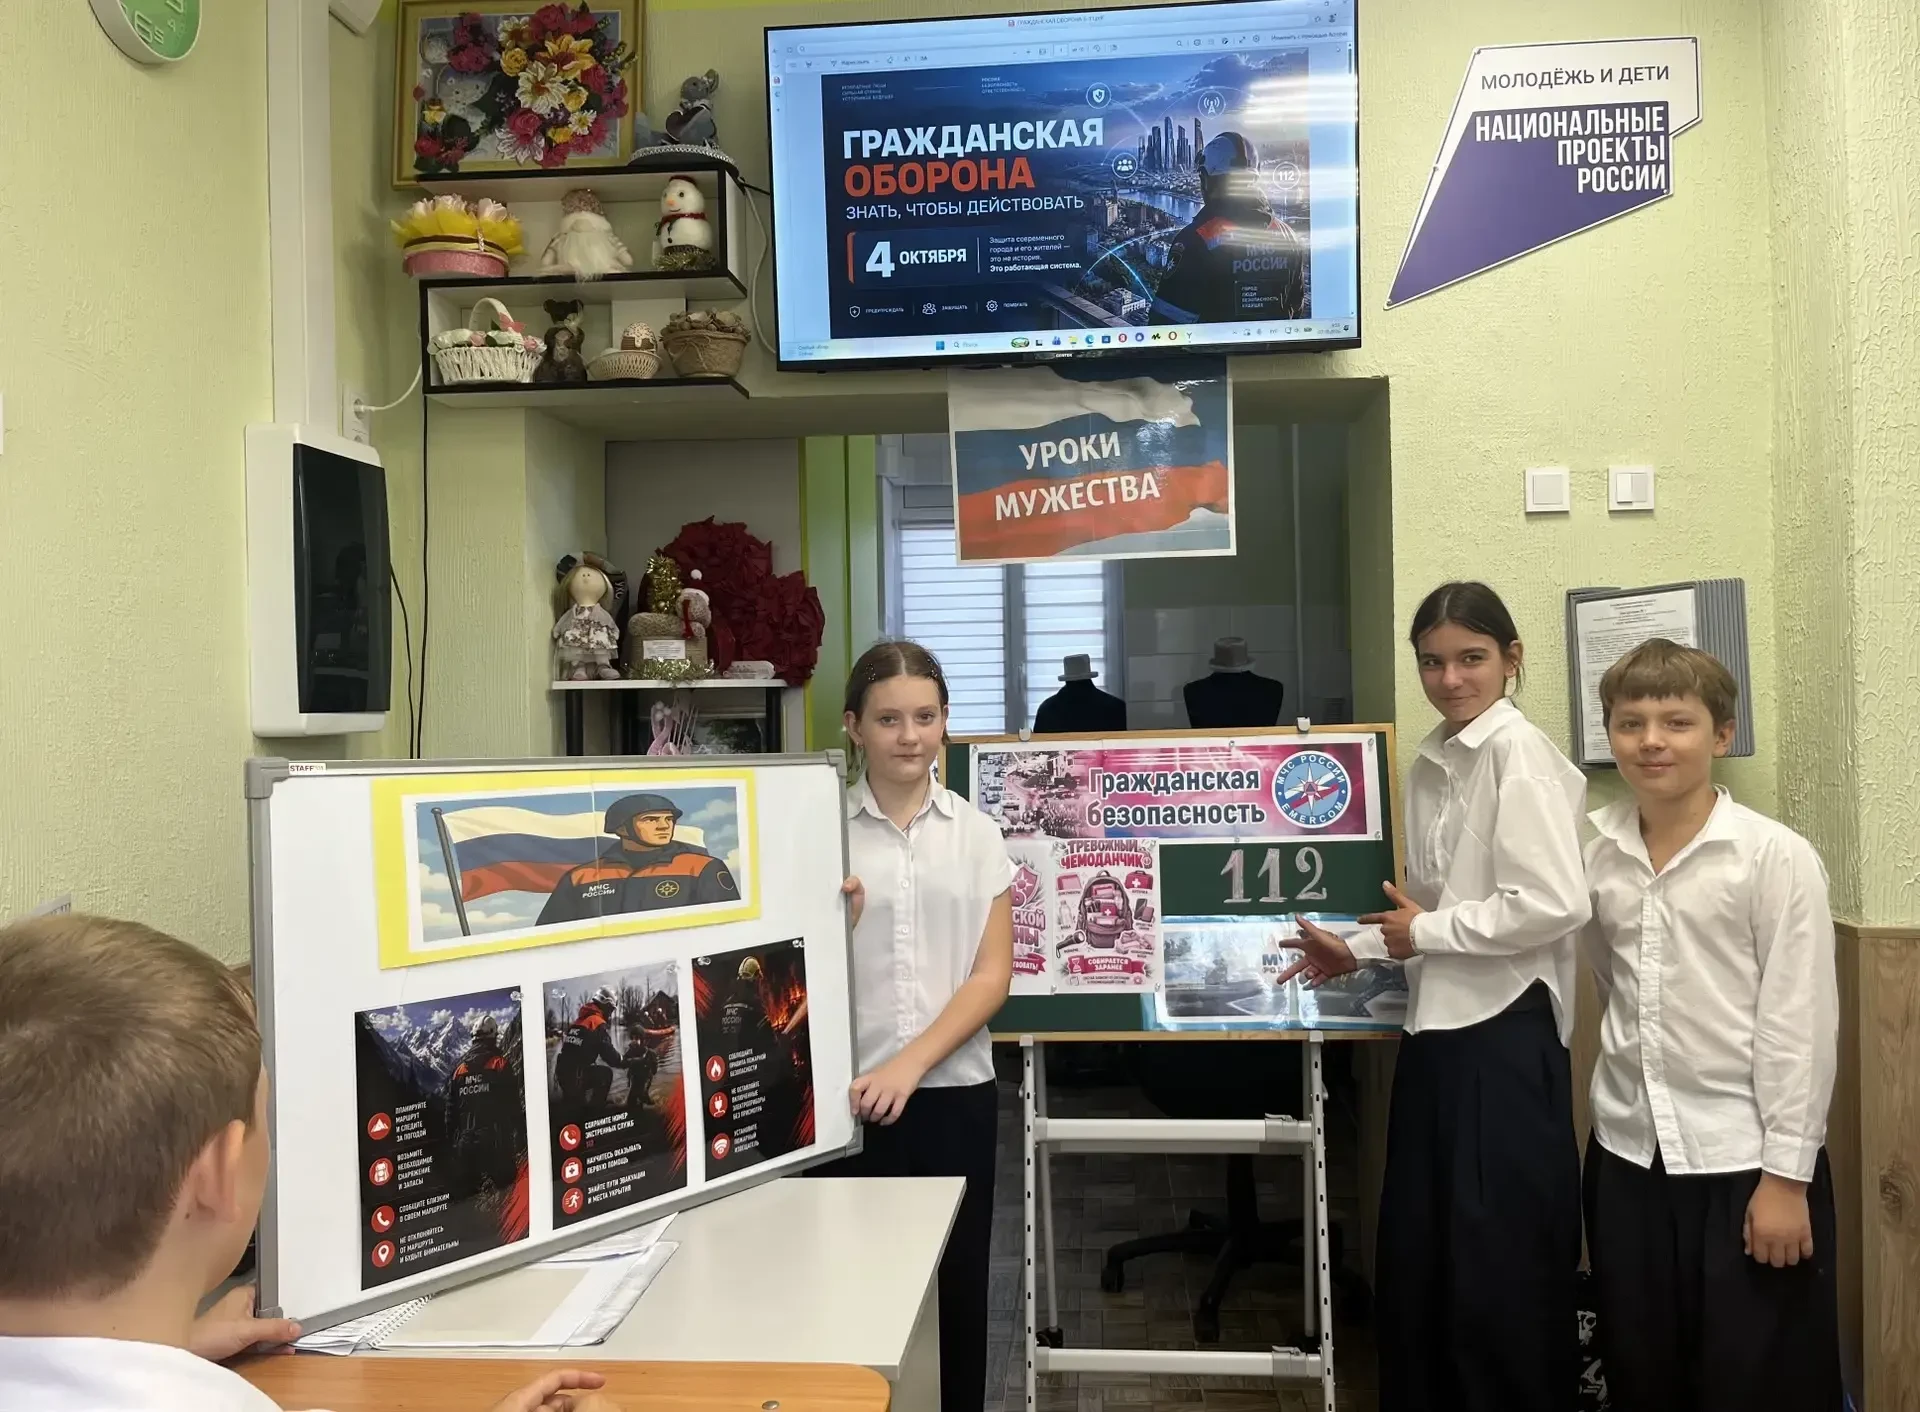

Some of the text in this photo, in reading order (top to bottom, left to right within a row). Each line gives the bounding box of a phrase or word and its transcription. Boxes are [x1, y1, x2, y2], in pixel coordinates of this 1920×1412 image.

[1481, 66, 1670, 90] МОЛОДЁЖЬ И ДЕТИ
[1475, 106, 1665, 142] НАЦИОНАЛЬНЫЕ
[843, 117, 1104, 159] ГРАЖДАНСКАЯ
[1557, 135, 1665, 166] ПРОЕКТЫ
[844, 157, 1036, 198] ОБОРОНА
[1278, 170, 1295, 182] 112
[1578, 164, 1666, 193] РОССИИ
[846, 196, 1084, 220] ЗНАТЬ, ЧТОБЫ ДЕЙСТВОВАТЬ
[989, 234, 1065, 244] Защита современного
[865, 240, 967, 278] 4 ОКТЯБРЯ
[990, 246, 1014, 254] города
[990, 262, 1082, 272] Это работающая система.
[1232, 256, 1288, 274] РОССИИ
[1018, 431, 1122, 470] УРОКИ
[995, 472, 1161, 521] МУЖЕСТВА
[1276, 754, 1346, 784] МЧС РОССИИ
[1089, 768, 1261, 798] Гражданская
[1086, 800, 1266, 827] безопасность
[1282, 802, 1344, 824] EMERCOM
[1067, 839, 1138, 853] ТРЕВОЖНЫЙ
[1060, 852, 1144, 869] ЧЕМОДАНЧИК
[1220, 846, 1328, 904] 112
[582, 888, 616, 898] РОССИИ
[588, 883, 610, 892] МЧС
[1012, 909, 1046, 932] СКОЙ
[1088, 957, 1129, 966] СОБИРАЕТСЯ
[465, 1074, 482, 1084] МЧС
[459, 1082, 490, 1096] РОССИИ
[396, 1101, 427, 1114] ПЛАНИРУЙТЕ
[396, 1112, 420, 1124] МАРШРУТ
[400, 1120, 422, 1132] СЛЕДИТЕ
[584, 1112, 628, 1130] СОХРАНИТЕ НОМЕР
[404, 1128, 427, 1140] ПОГОДОЙ
[585, 1120, 634, 1139] ЭКСТРЕННЫХ СЛУЖБ
[397, 1148, 422, 1162] ВОЗЬМИТЕ
[397, 1156, 433, 1170] НЕОБХОДИМОЕ
[586, 1144, 642, 1164] НАУЧИТЕСЬ ОКАЗЫВАТЬ
[398, 1166, 431, 1180] СНАРЯЖЕНИЕ
[586, 1156, 628, 1174] ПЕРВУЮ ПОМОЩЬ
[403, 1178, 424, 1189] ЗАПАСЫ
[588, 1170, 646, 1194] ЗНАЙТЕ ПУТИ ЭВАКУАЦИИ
[592, 1192, 608, 1202] МЕСТА
[608, 1184, 632, 1198] УКРЫТИЯ
[399, 1192, 450, 1213] СООБЩИТЕ БЛИЗКИМ
[404, 1210, 420, 1222] СВОЕМ
[422, 1202, 448, 1216] МАРШРУТЕ
[400, 1226, 444, 1244] НЕ ОТКЛОНЯЙТЕСЬ
[400, 1238, 434, 1254] ОТ МАРШРУТА
[400, 1240, 460, 1264] И БУДЬТЕ ВНИМАТЕЛЬНЫ
